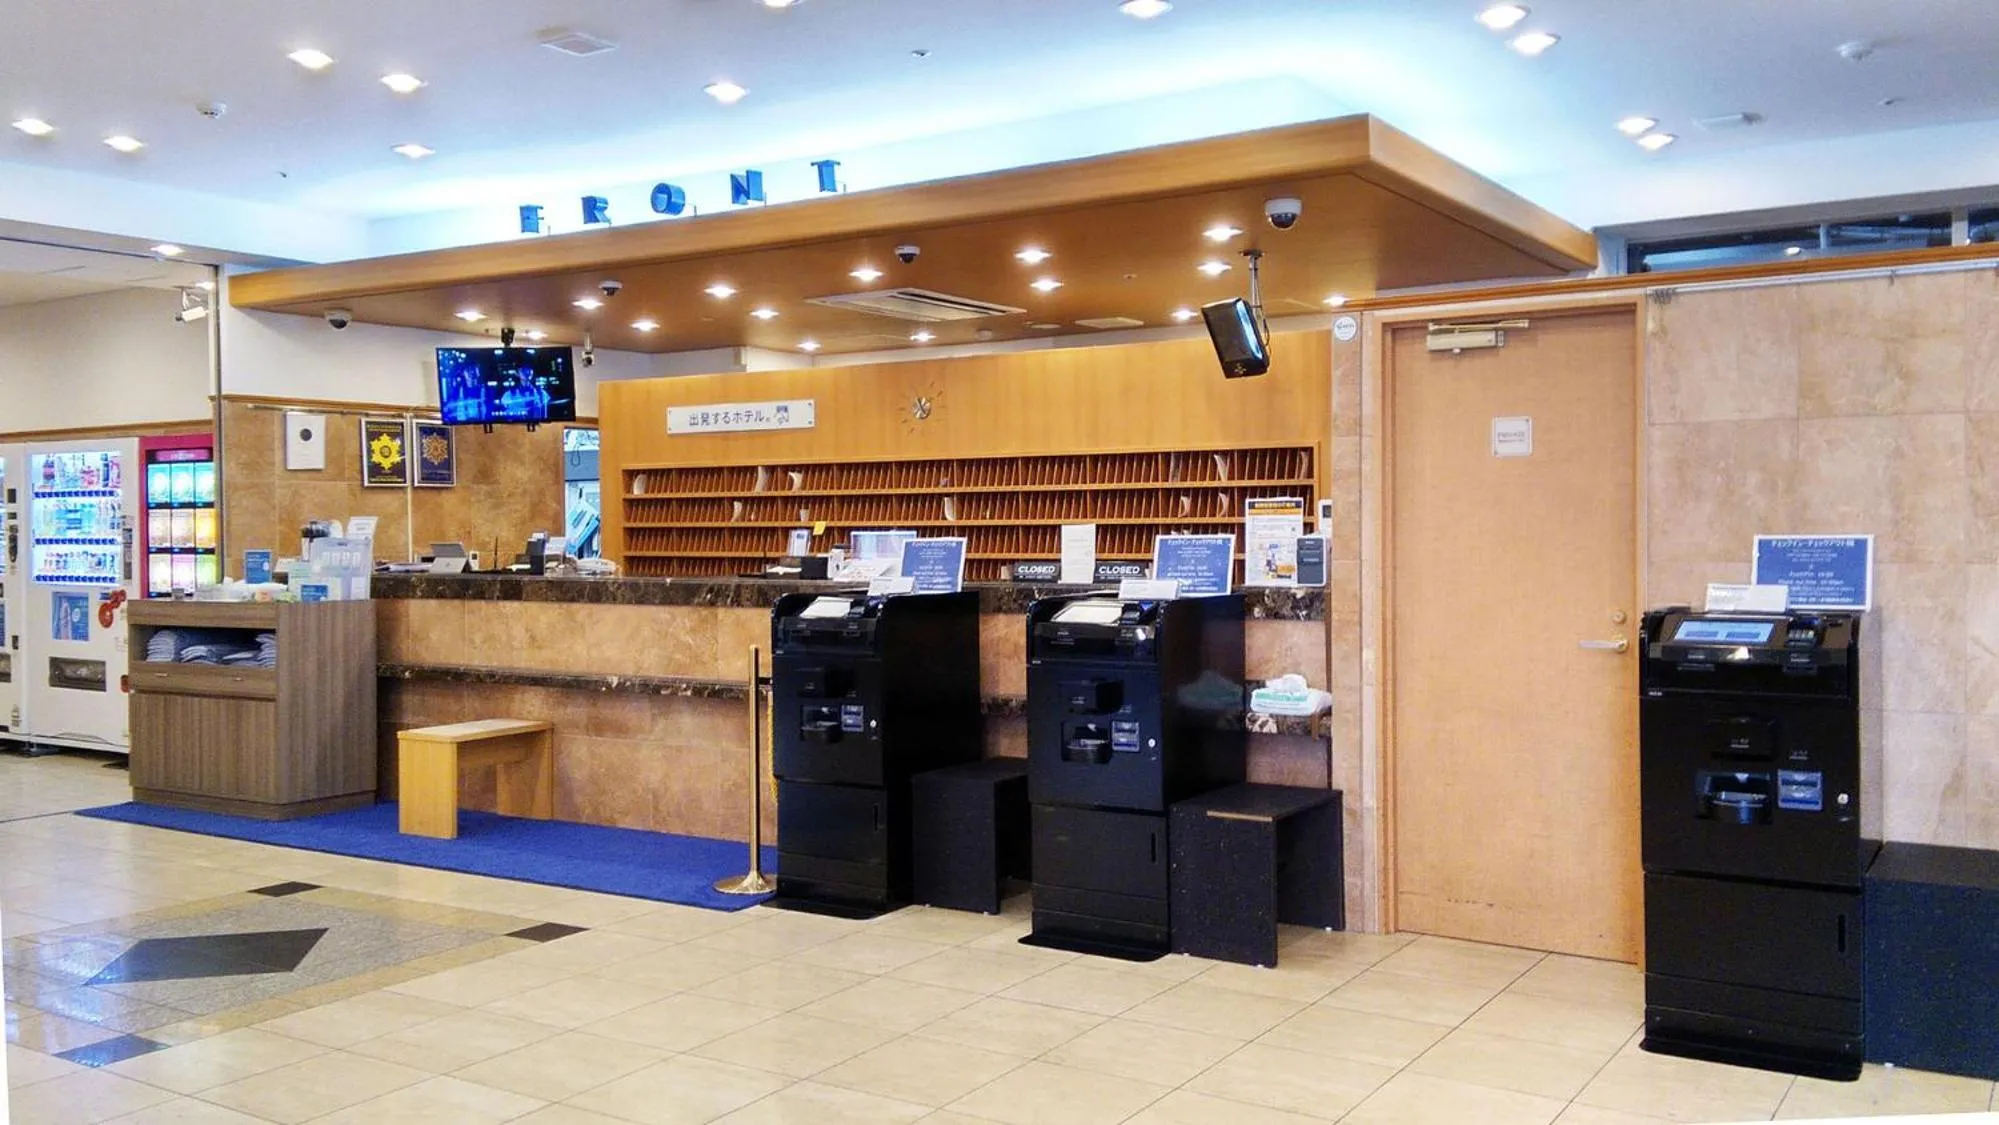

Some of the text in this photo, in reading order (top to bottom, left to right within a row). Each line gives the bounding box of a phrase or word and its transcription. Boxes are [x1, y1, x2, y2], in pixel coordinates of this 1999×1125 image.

[519, 159, 841, 233] FRONT
[688, 410, 770, 426] 出発するホテル。
[1018, 565, 1056, 574] CLOSED
[1099, 565, 1141, 574] CLOSED
